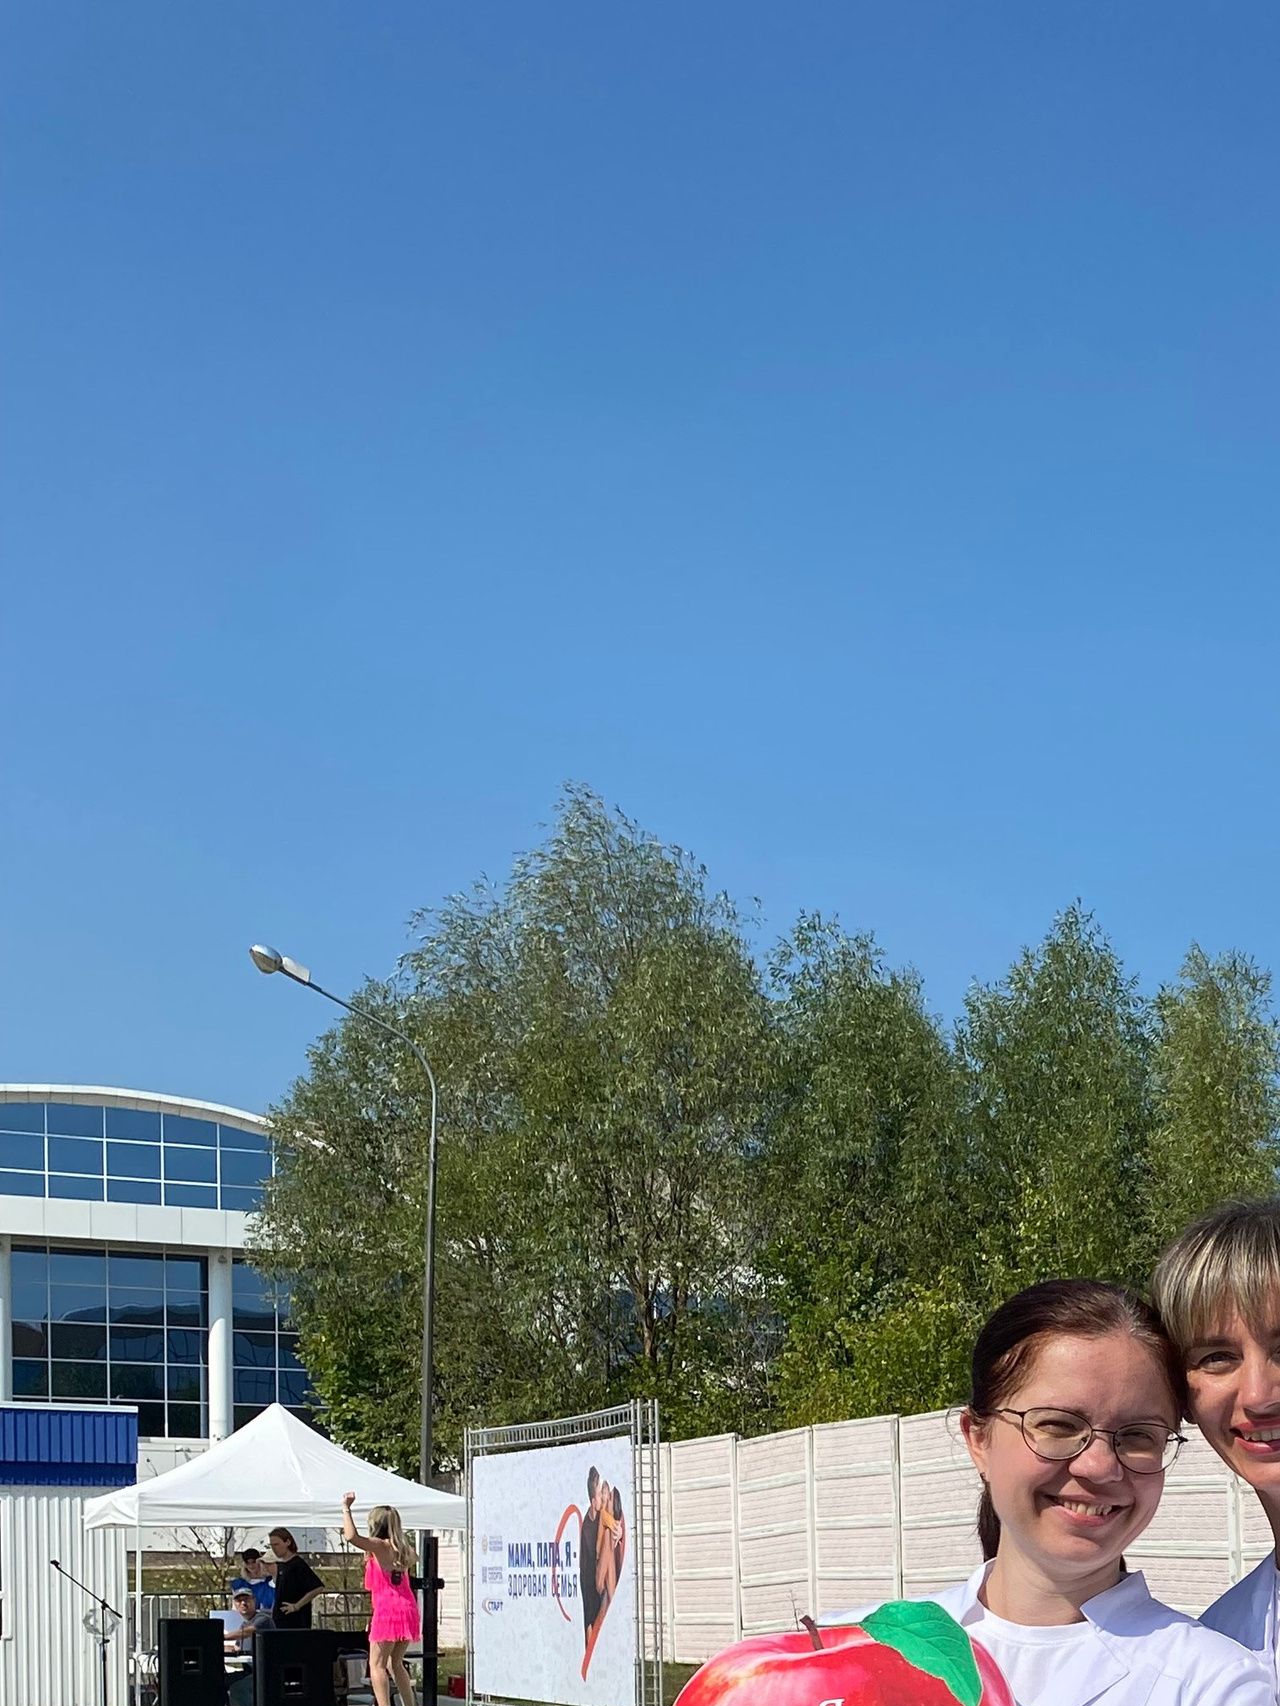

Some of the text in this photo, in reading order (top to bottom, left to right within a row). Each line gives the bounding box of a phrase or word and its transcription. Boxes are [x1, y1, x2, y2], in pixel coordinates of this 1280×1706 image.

[508, 1542, 535, 1572] МАМА,
[537, 1542, 564, 1572] ПАПА,
[565, 1541, 571, 1567] Я
[508, 1573, 577, 1600] ЗДОРОВАЯ СЕМЬЯ
